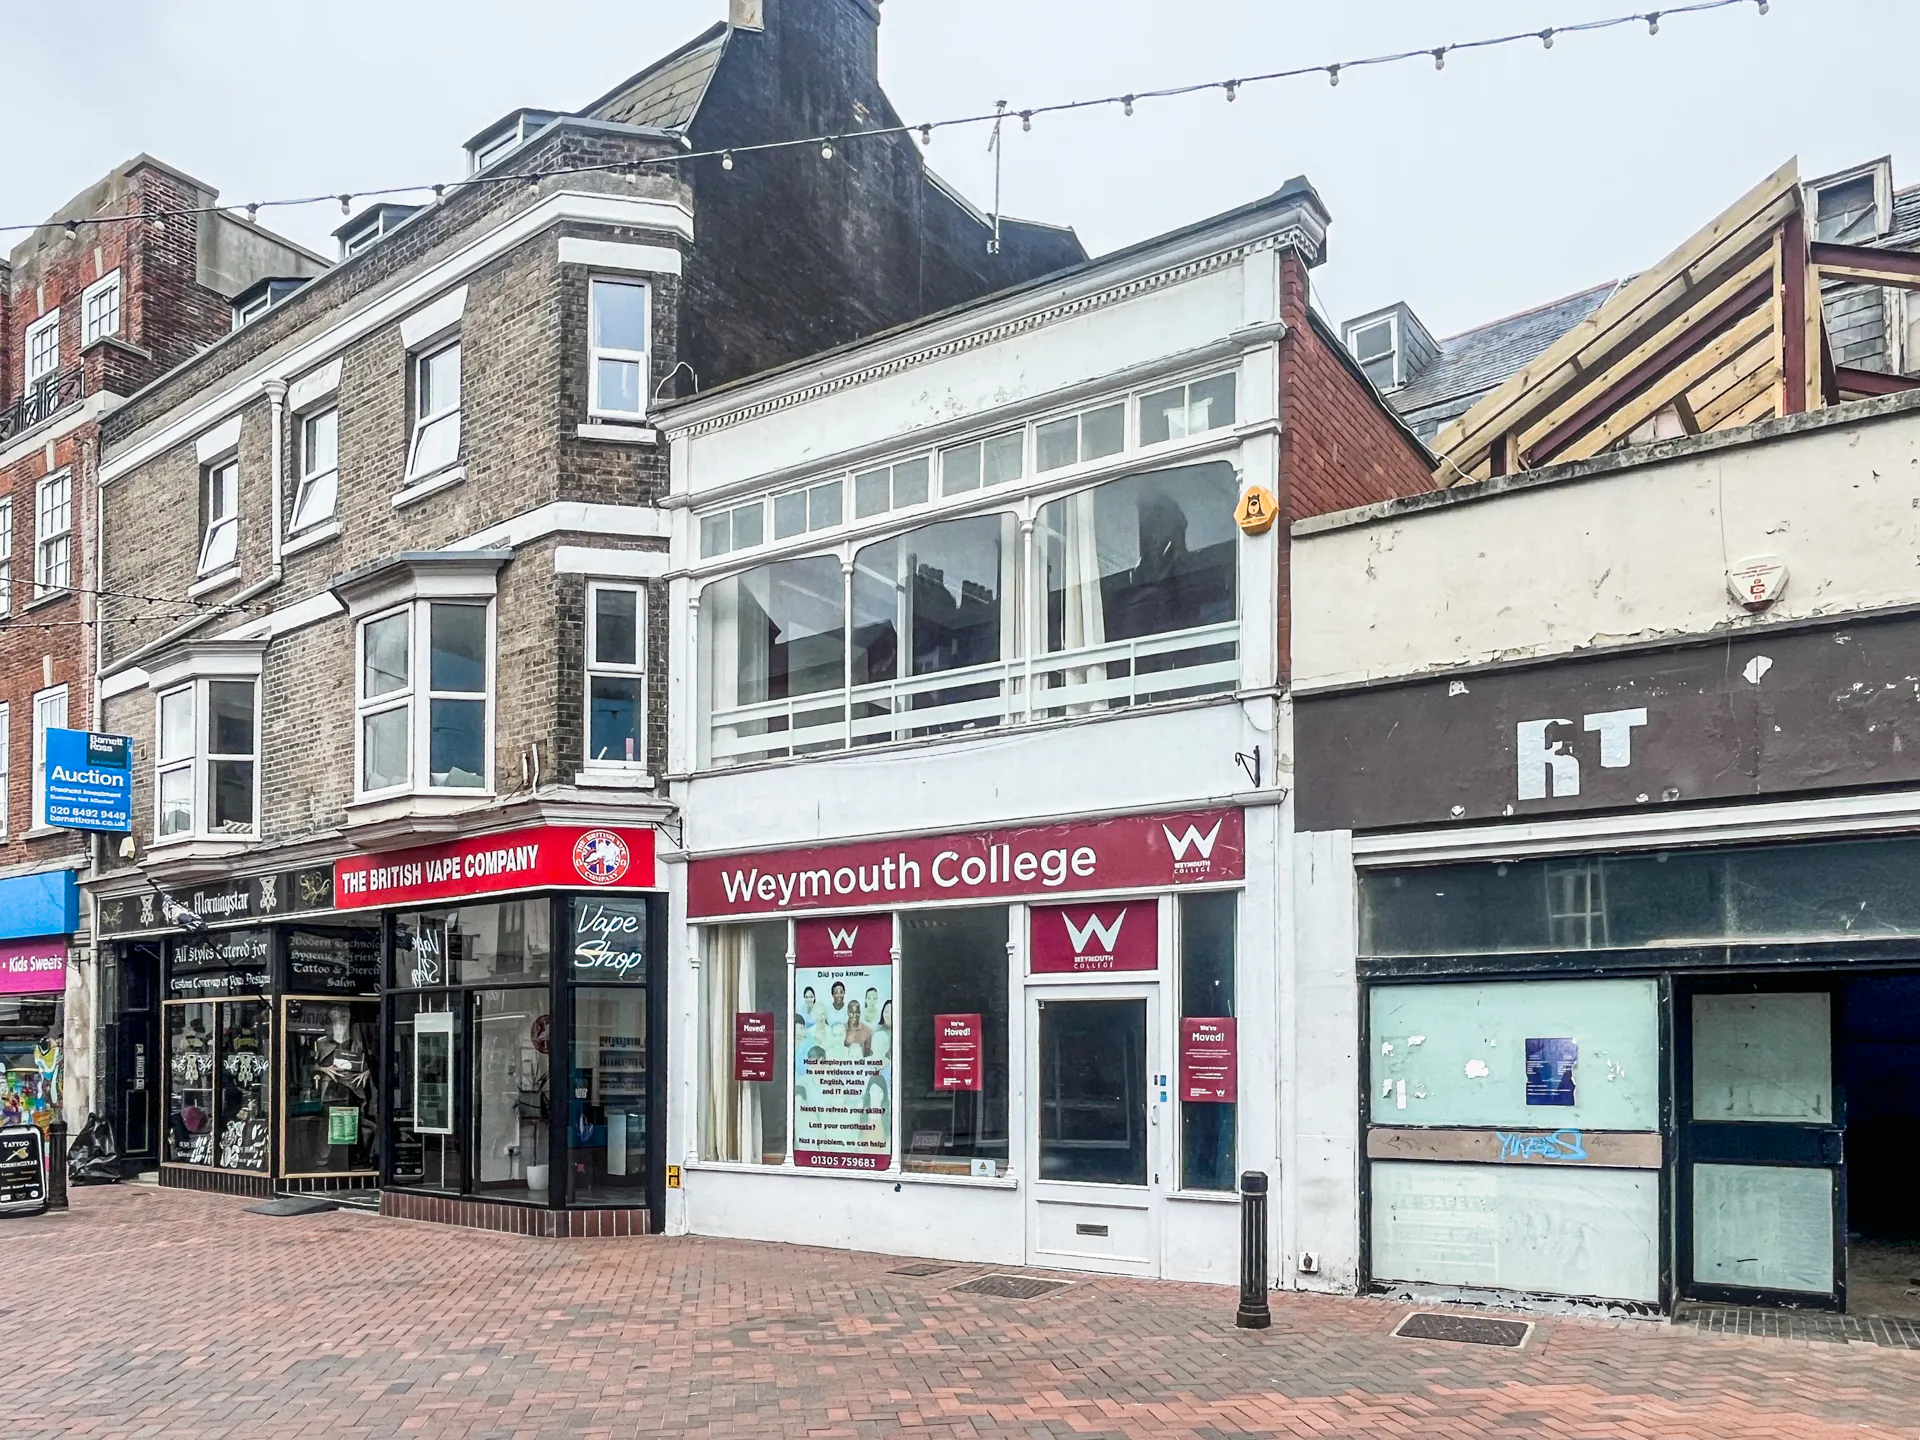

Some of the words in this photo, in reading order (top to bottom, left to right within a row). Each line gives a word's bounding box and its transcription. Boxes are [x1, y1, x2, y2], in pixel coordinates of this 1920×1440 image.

[90, 735, 123, 746] Barnett
[90, 743, 113, 752] Ross
[51, 766, 124, 786] Auction
[50, 806, 70, 815] 020
[72, 808, 98, 817] 8492
[101, 810, 126, 820] 9449
[50, 815, 125, 827] barnettross.co.uk
[342, 871, 367, 894] THE
[369, 863, 422, 891] BRITISH
[425, 856, 461, 883] VAPE
[464, 845, 539, 878] COMPANY
[721, 851, 921, 906] Weymouth
[931, 844, 1097, 886] College
[1174, 866, 1210, 874] COLLEGE
[584, 871, 618, 882] COMPANY
[194, 891, 249, 916] Morningstar
[577, 904, 639, 941] Vape
[335, 939, 380, 949] Technolo
[174, 945, 188, 963] All
[188, 943, 214, 965] Styles
[574, 940, 642, 977] Shop
[9, 956, 28, 972] Kids
[30, 954, 62, 972] Sweets
[292, 963, 330, 974] Tattoo
[333, 966, 342, 974] &
[346, 966, 380, 976] Piercin
[327, 976, 356, 987] Salon
[944, 1028, 971, 1036] Moved!
[1192, 1032, 1225, 1042] Moved!
[811, 1156, 839, 1165] 01305
[841, 1157, 876, 1167] 759683
